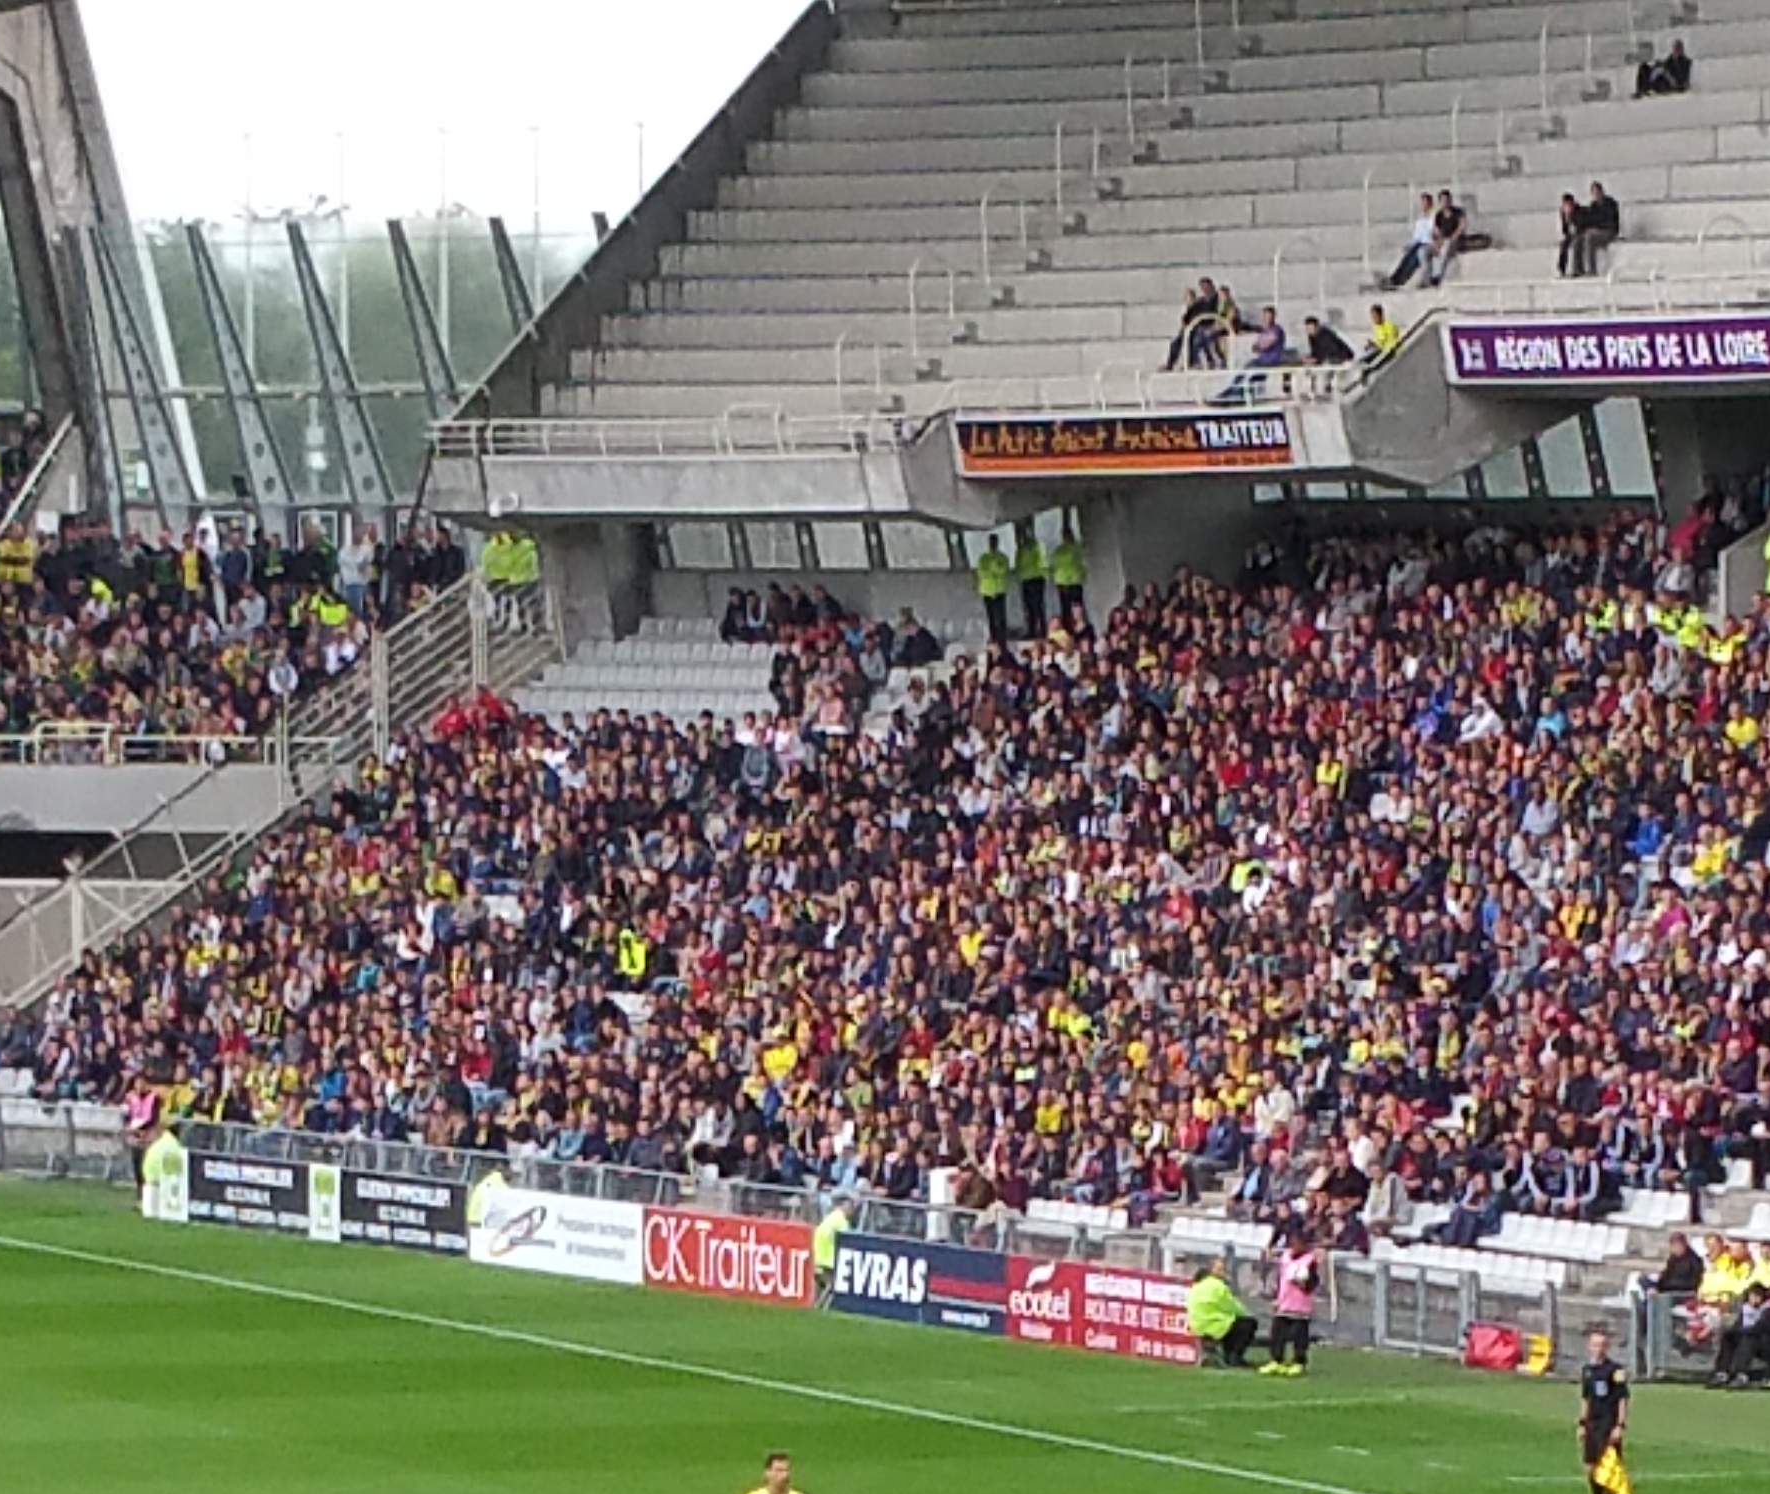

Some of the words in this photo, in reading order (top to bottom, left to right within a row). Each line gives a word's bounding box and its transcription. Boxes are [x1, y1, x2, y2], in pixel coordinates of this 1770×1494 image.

[1564, 336, 1603, 370] DES
[1604, 334, 1653, 369] PAYS
[1655, 333, 1683, 367] DE
[1685, 333, 1712, 366] LA
[1714, 330, 1770, 366] LOIRE
[1195, 418, 1287, 447] TRAITEUR
[644, 1213, 695, 1284] CK
[693, 1218, 811, 1300] Traiteur
[833, 1247, 929, 1304] EVRAS
